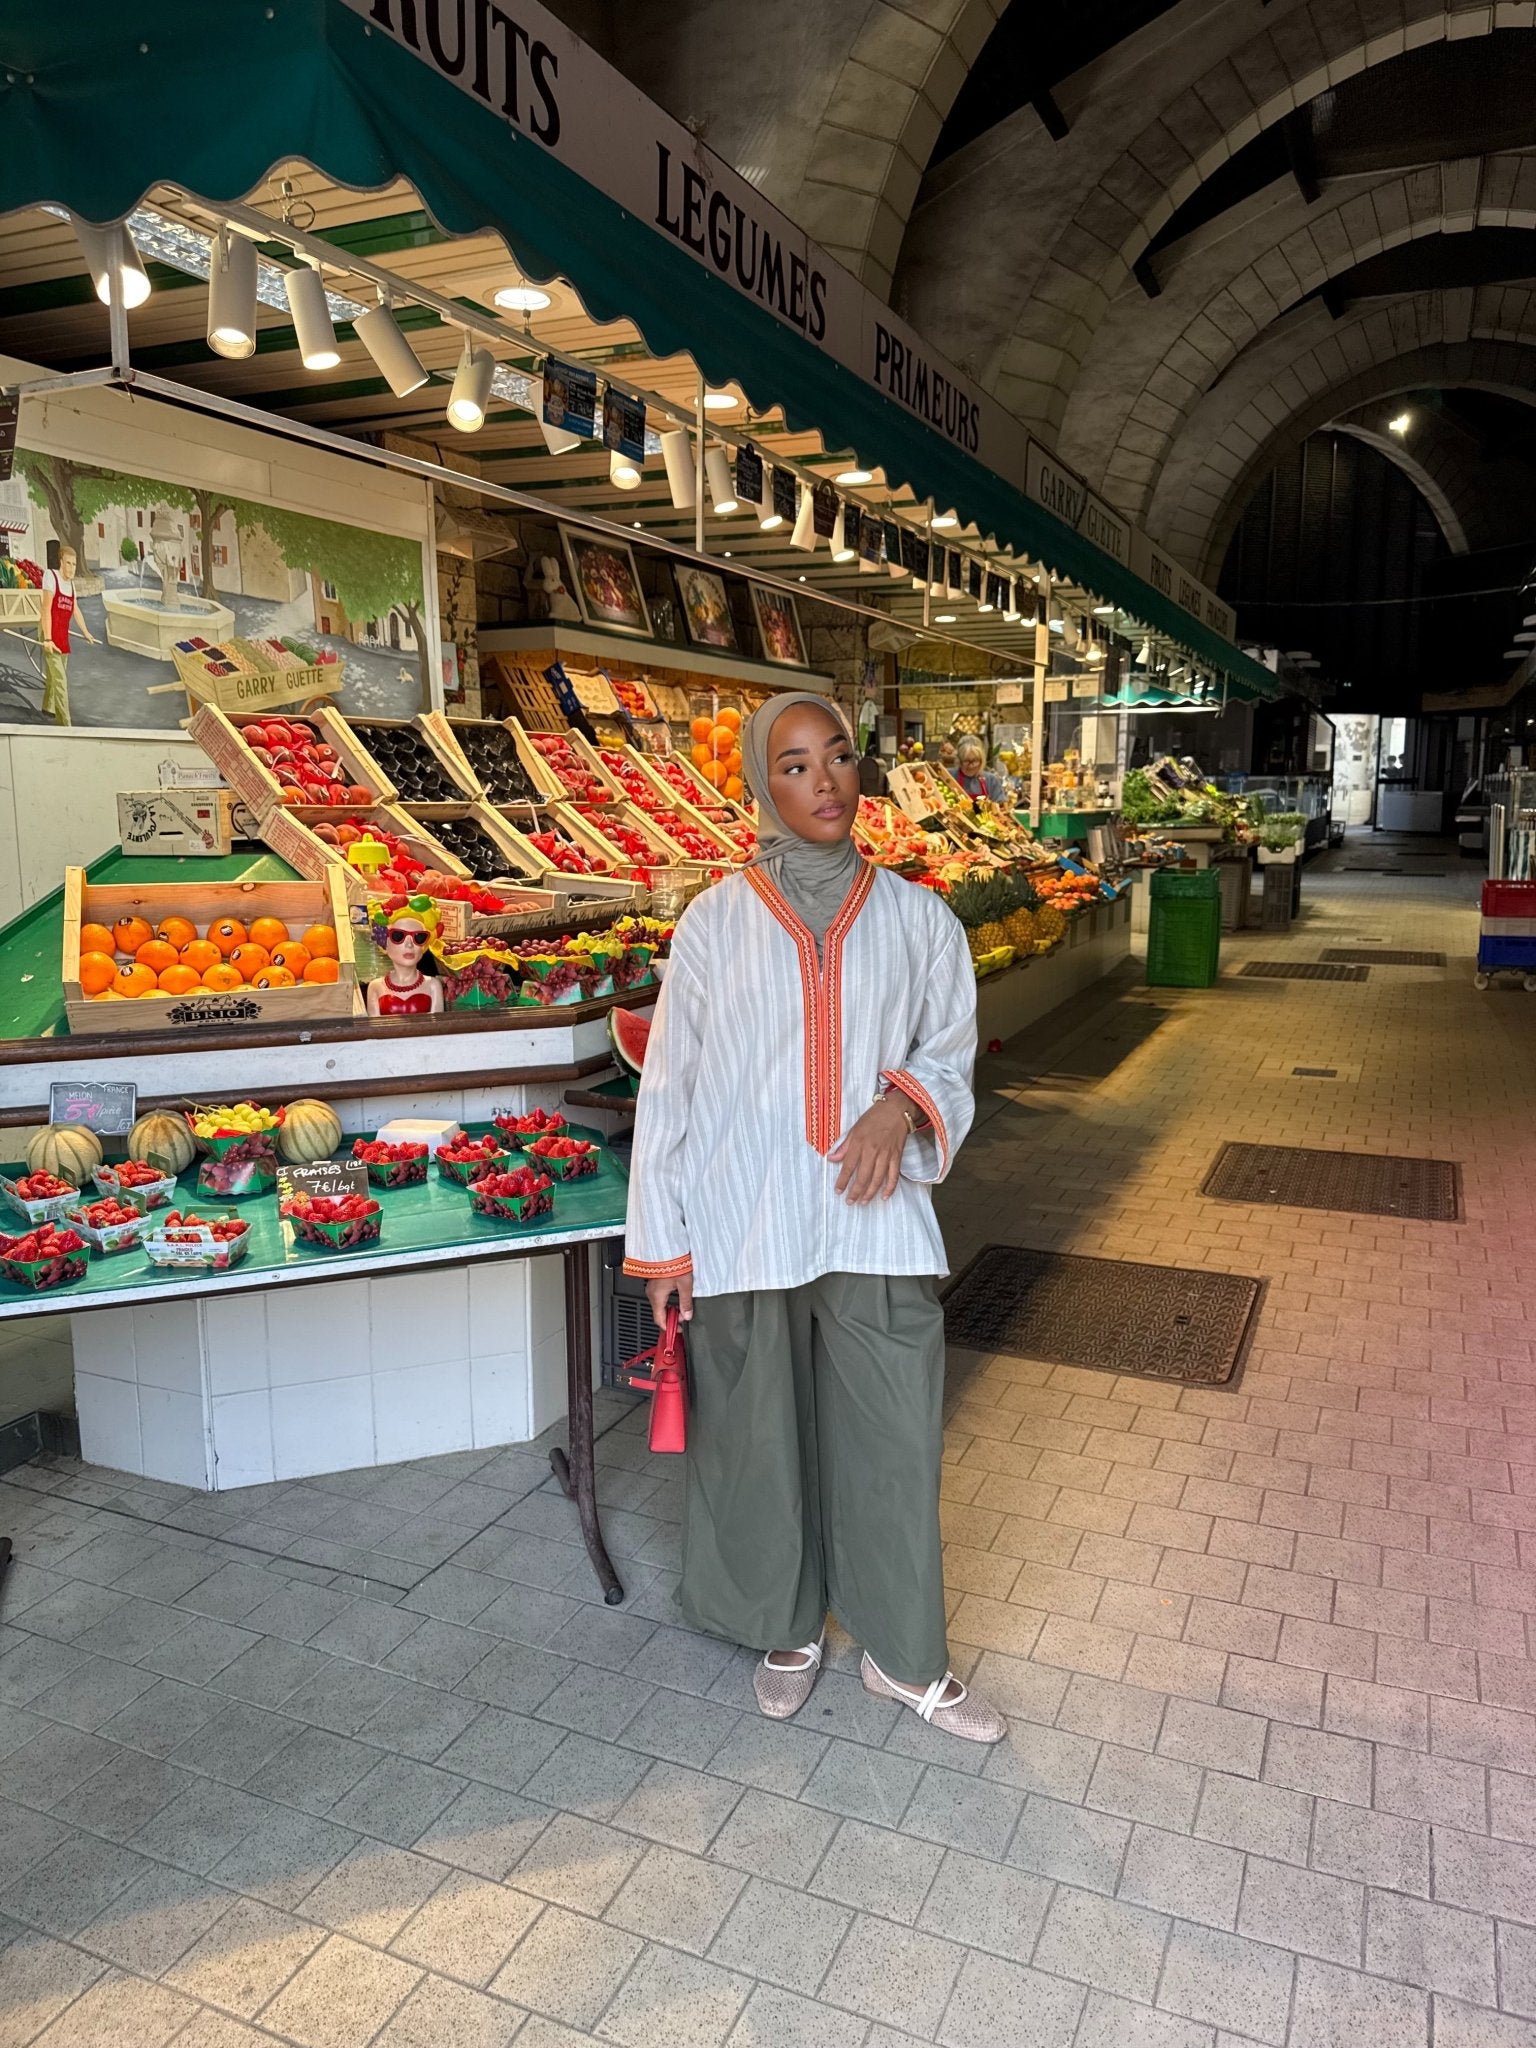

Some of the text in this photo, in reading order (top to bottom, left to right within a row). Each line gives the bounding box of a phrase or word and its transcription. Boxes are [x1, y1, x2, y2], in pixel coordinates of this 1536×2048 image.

[655, 140, 827, 342] LEGUMES
[873, 320, 981, 454] PRIMEURS
[1040, 466, 1080, 523] GARRY
[1087, 504, 1123, 559] GUETTE
[236, 667, 324, 700] GARRY GUETTE
[191, 1008, 240, 1020] BRIO
[68, 1091, 93, 1100] MELON
[103, 1086, 129, 1094] FRANCE
[293, 1164, 342, 1178] FRAISES
